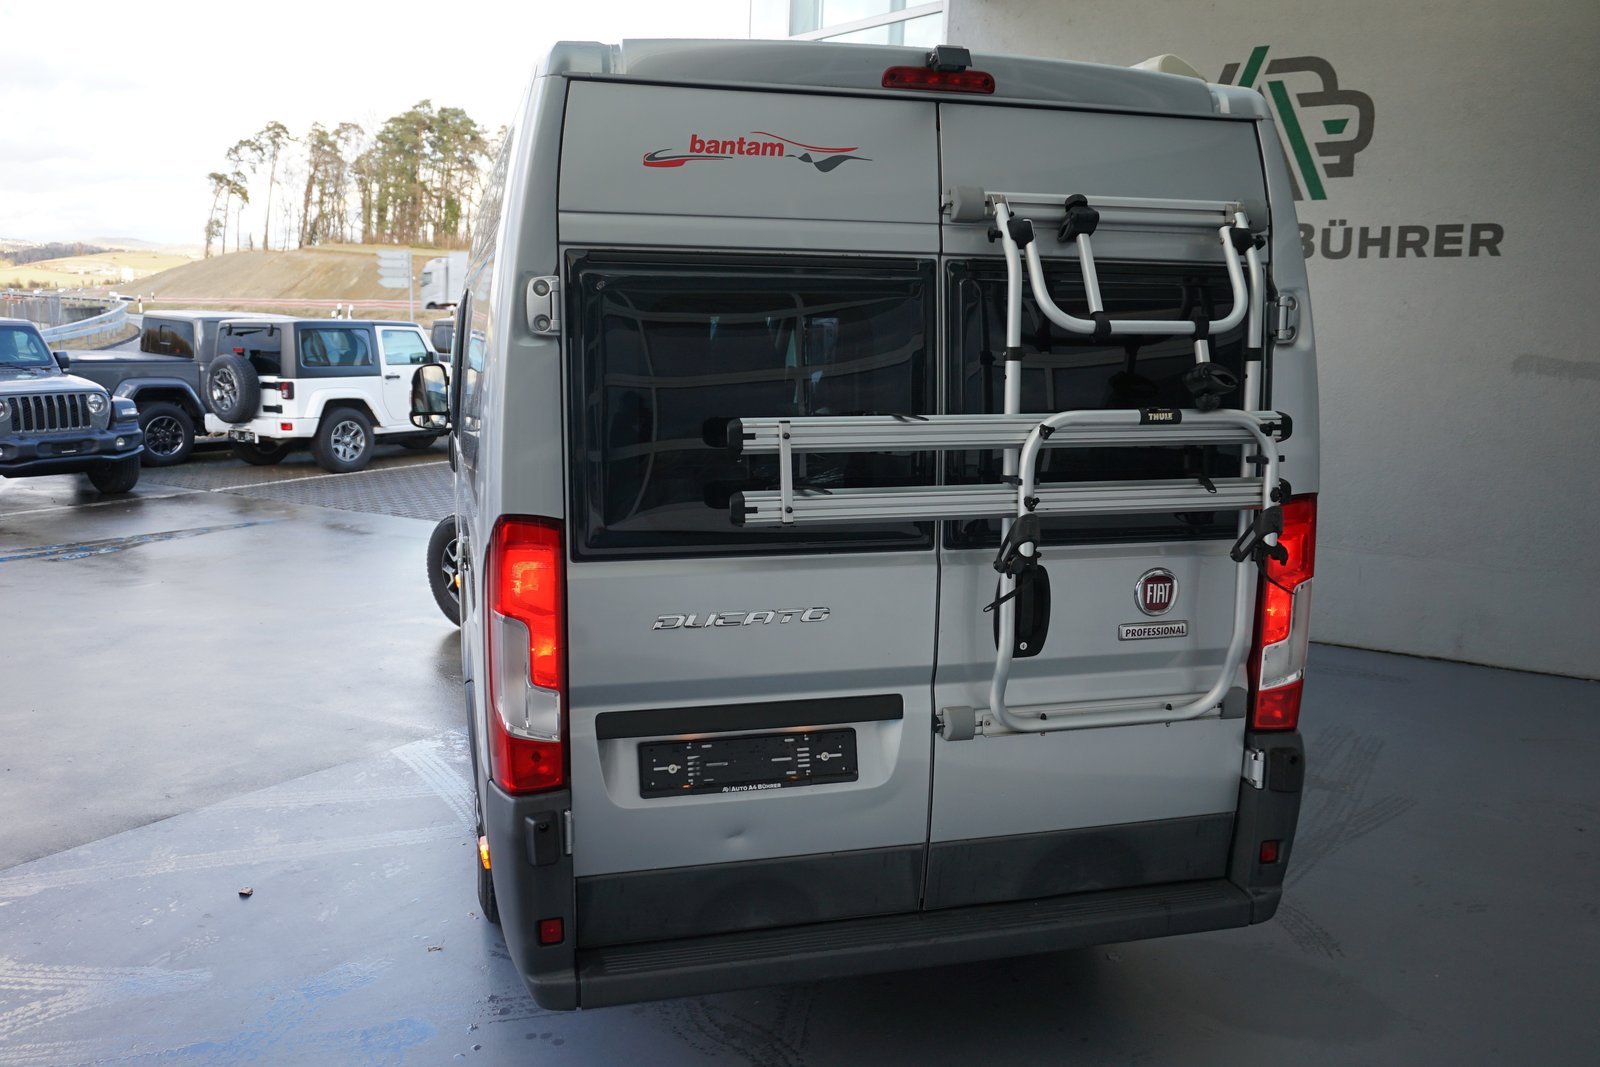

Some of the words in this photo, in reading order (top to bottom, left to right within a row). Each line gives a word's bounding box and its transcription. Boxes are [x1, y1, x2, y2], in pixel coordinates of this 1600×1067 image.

[689, 134, 785, 157] bantam
[1148, 412, 1173, 421] THULE
[1146, 583, 1172, 604] FIAT
[652, 606, 831, 631] DUCATO
[1125, 625, 1186, 638] PROFESSIONAL
